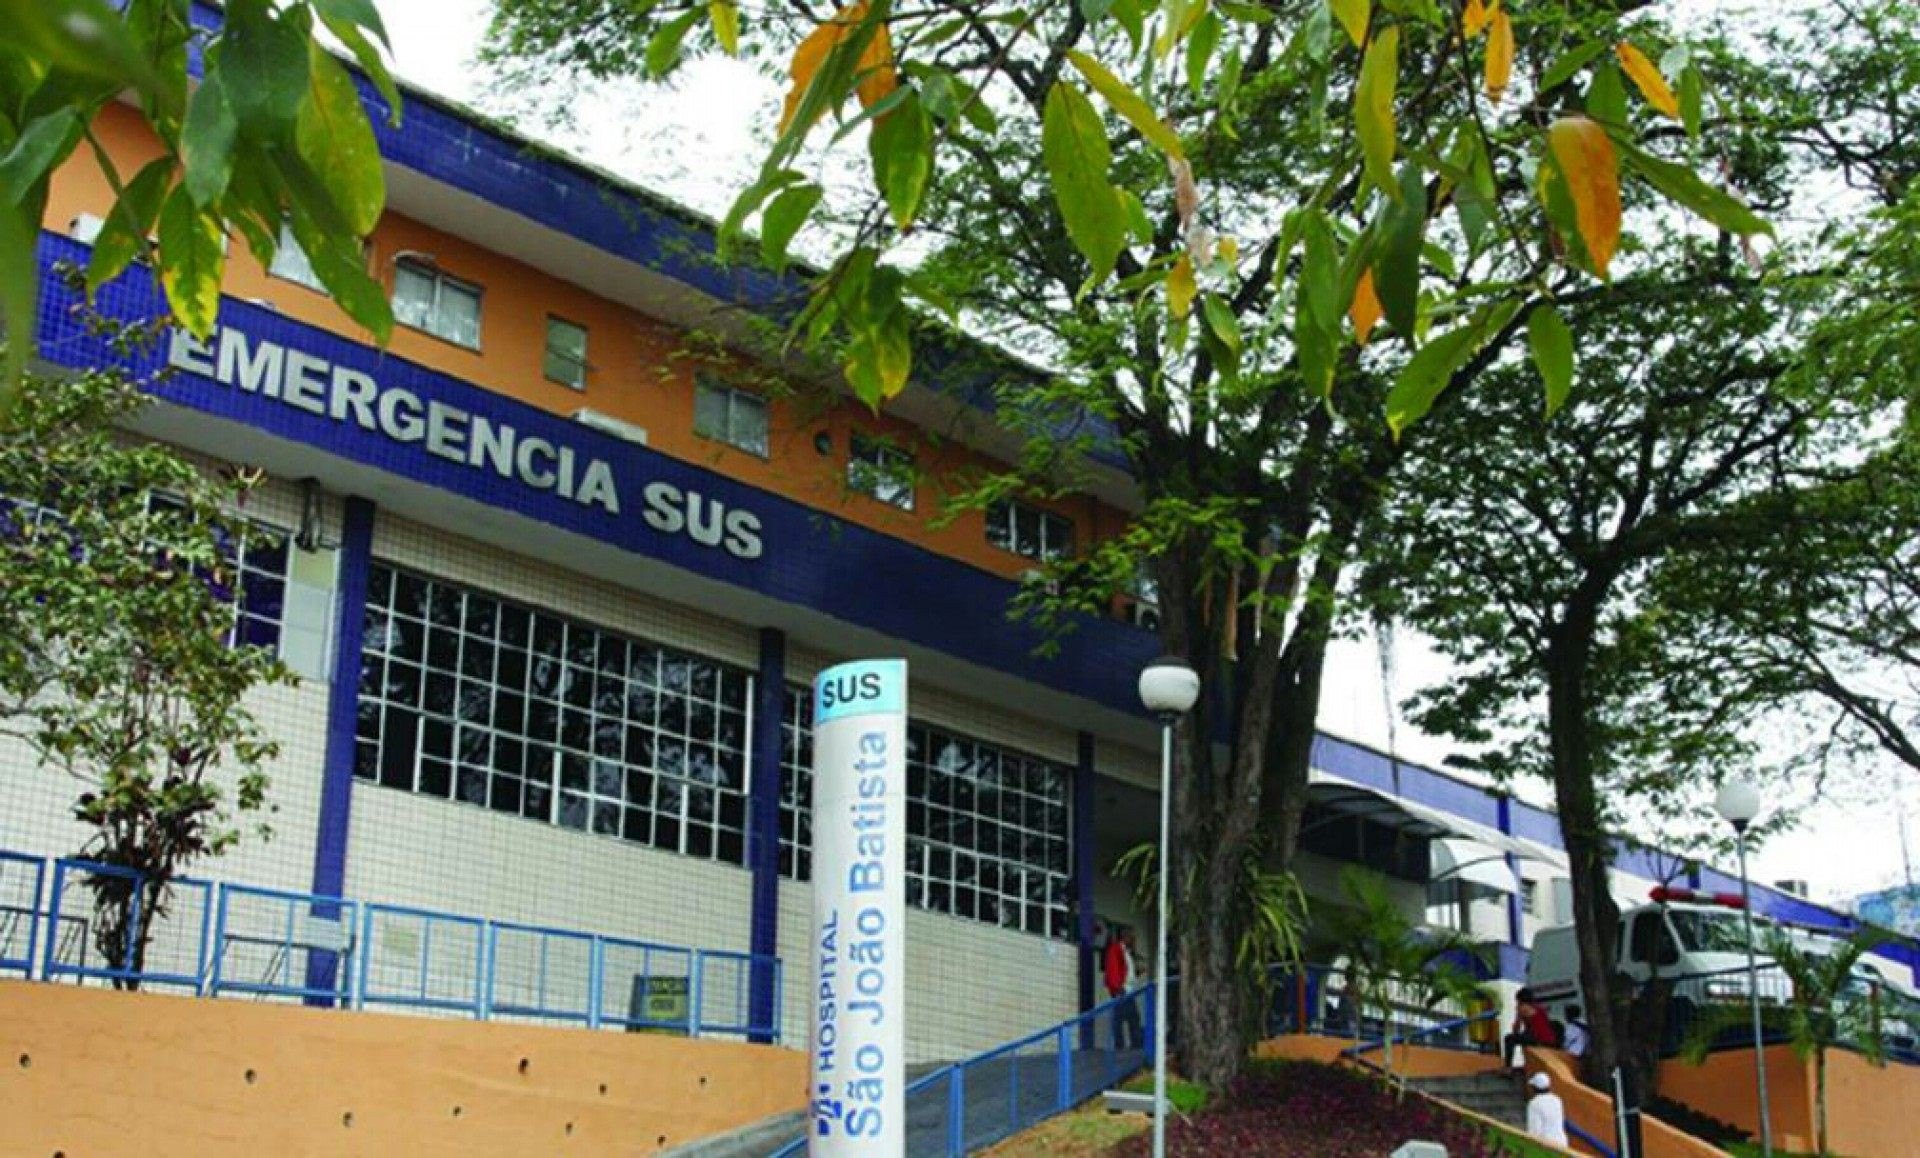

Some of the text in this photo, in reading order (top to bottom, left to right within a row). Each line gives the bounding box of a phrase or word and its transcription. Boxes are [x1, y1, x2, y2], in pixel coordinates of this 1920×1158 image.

[168, 324, 763, 559] EMERGENCIA SUS
[822, 671, 881, 709] SUS
[818, 909, 838, 1072] HOSPITAL
[844, 731, 887, 1138] São João Batista
